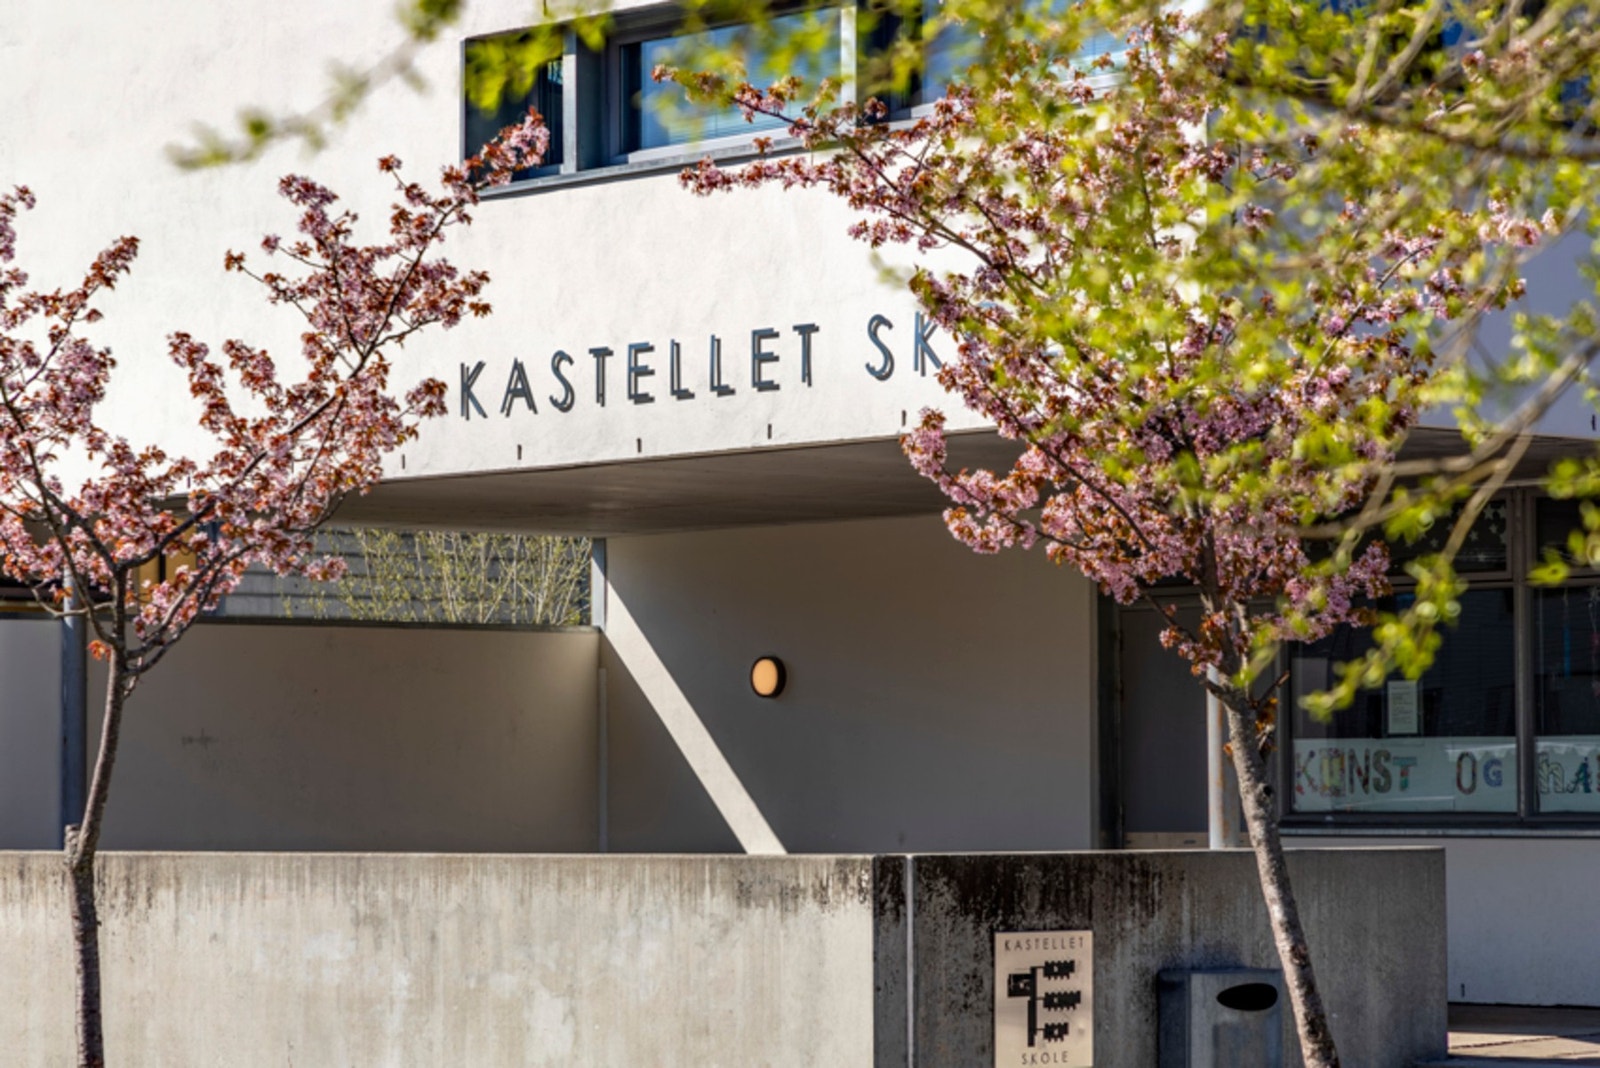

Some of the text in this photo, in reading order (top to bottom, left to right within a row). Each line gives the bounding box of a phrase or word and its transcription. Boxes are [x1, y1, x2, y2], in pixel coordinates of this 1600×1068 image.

[460, 310, 943, 420] KASTELLET SK
[1295, 747, 1418, 797] KUNST
[1456, 751, 1503, 795] OG
[1005, 937, 1084, 951] KASTELLET
[1021, 1051, 1069, 1065] SKOLE
